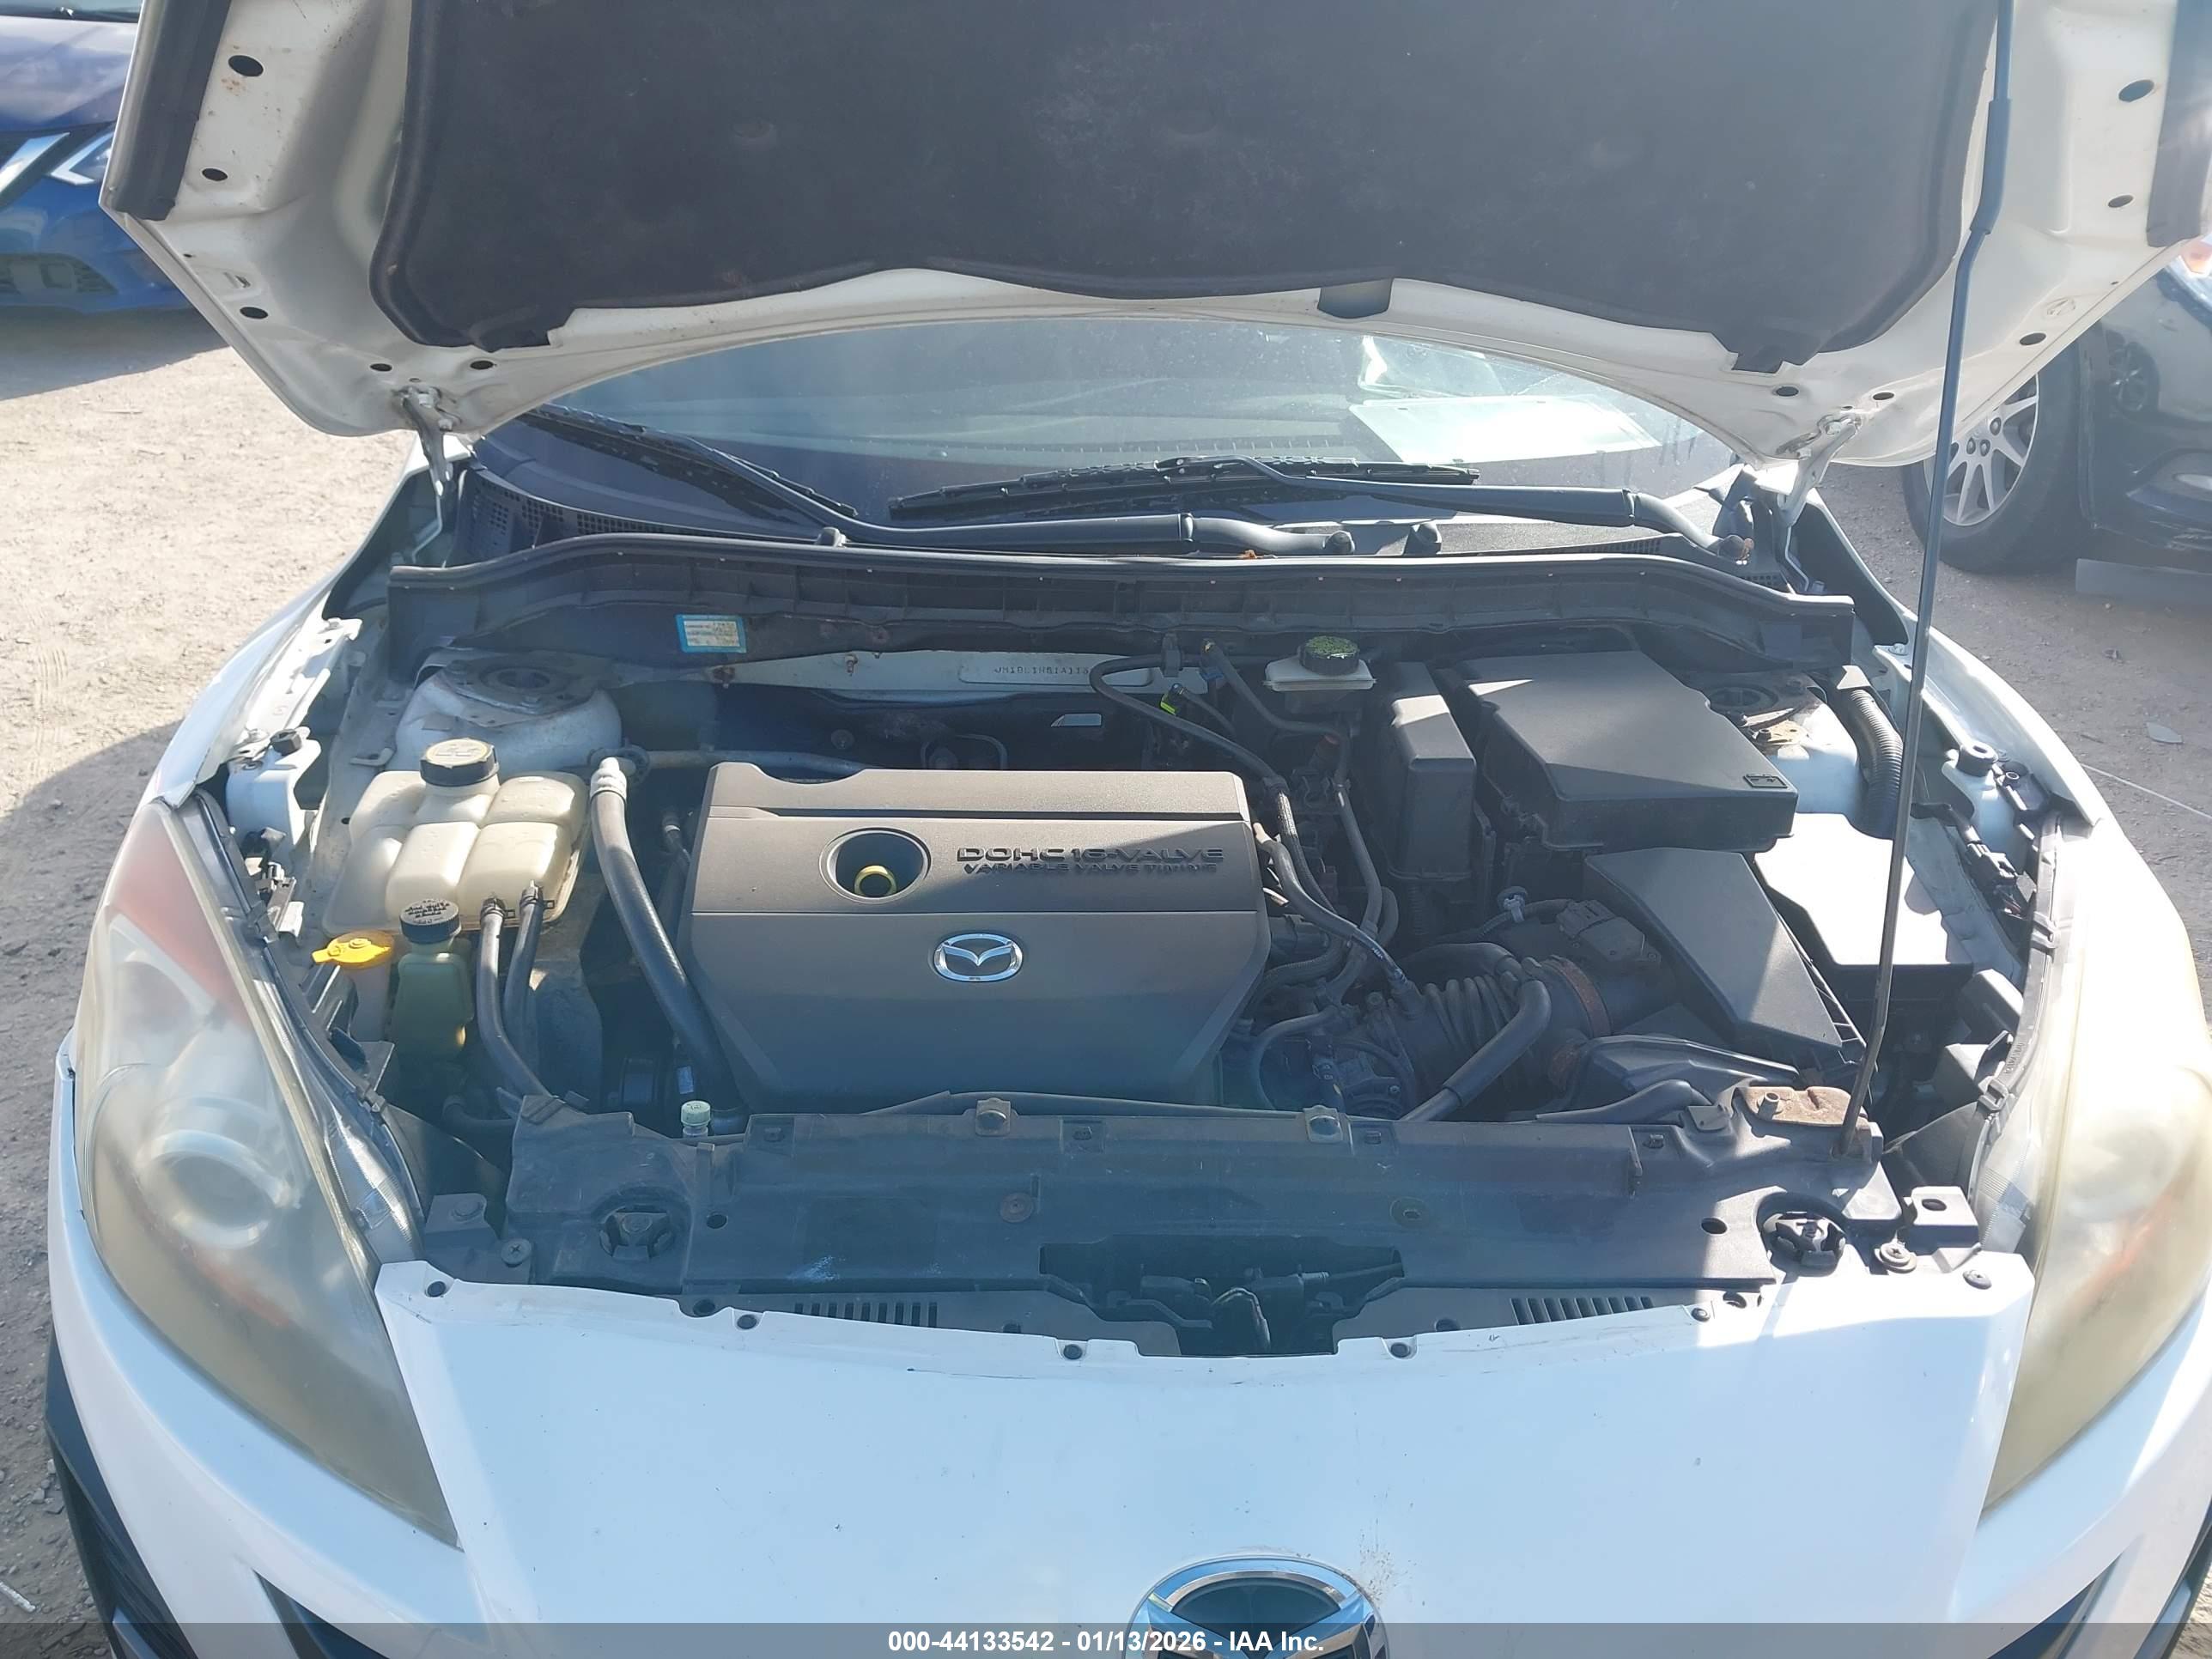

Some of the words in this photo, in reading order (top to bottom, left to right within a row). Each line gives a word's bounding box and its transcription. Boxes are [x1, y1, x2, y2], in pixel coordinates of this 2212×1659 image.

[957, 847, 1066, 862] DOHC
[1070, 847, 1224, 863] 16-VALVE
[963, 862, 1070, 874] VARIABLE
[1073, 862, 1141, 874] VALVE
